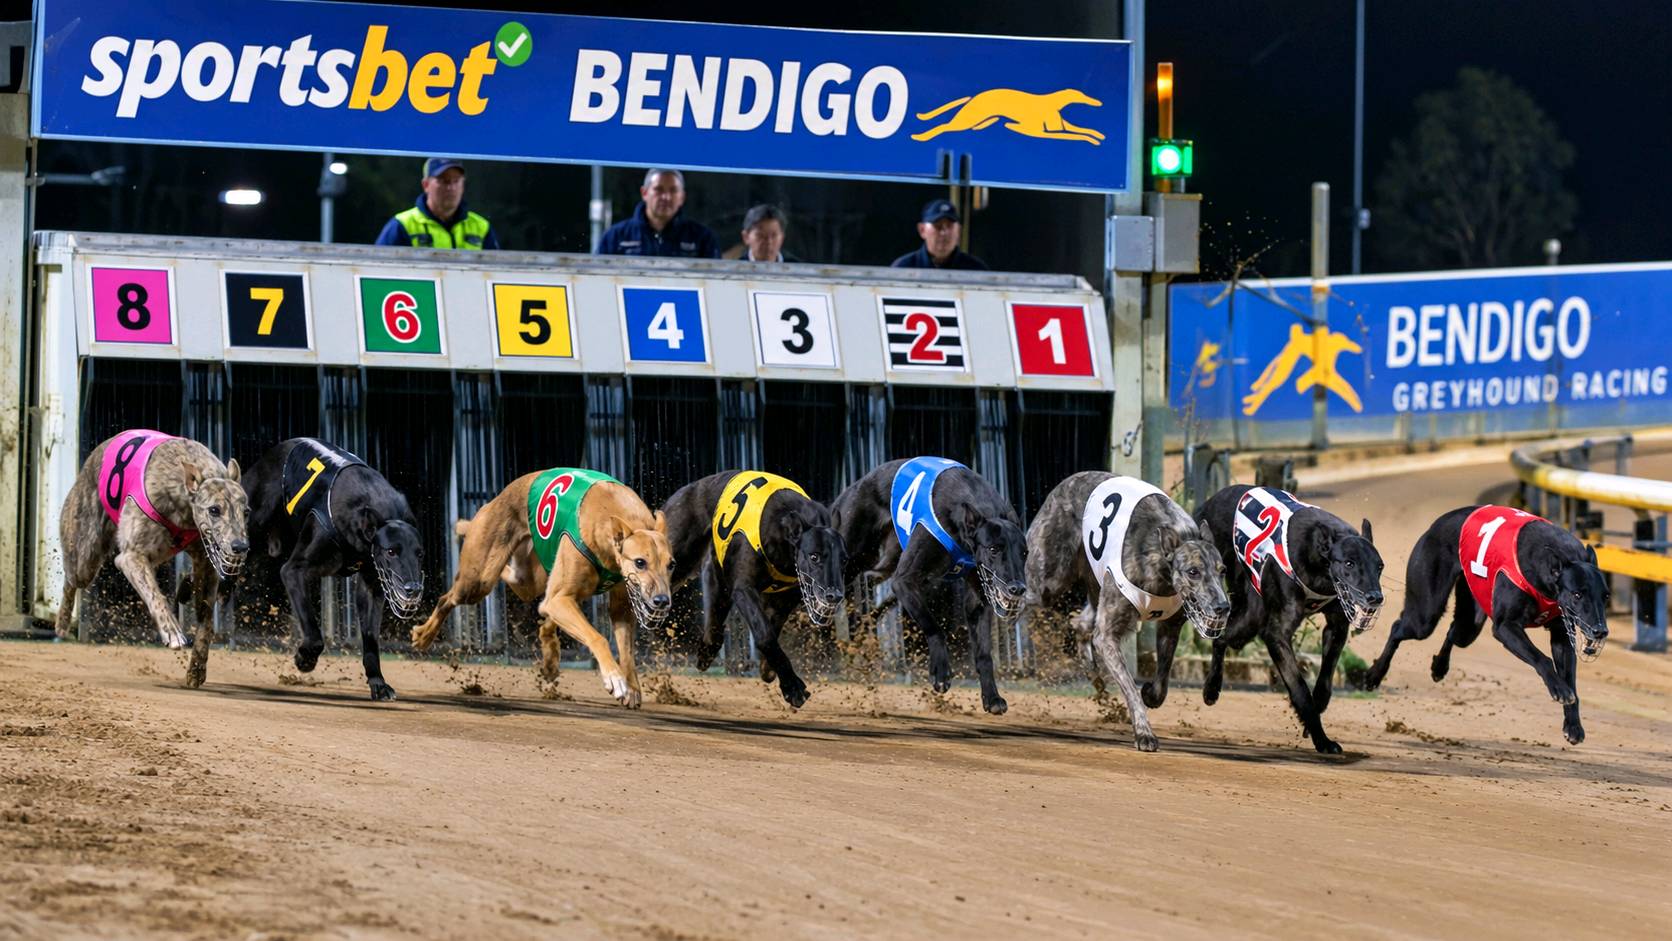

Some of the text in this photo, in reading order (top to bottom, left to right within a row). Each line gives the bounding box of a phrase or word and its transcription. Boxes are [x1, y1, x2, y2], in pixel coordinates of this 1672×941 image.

[81, 25, 909, 139] sportsbet BENDIGO
[117, 282, 151, 330] 8
[249, 287, 284, 335] 7
[381, 290, 421, 343] 6
[518, 299, 551, 345] 5
[647, 301, 684, 349] 4
[781, 307, 814, 354] 3
[1386, 296, 1591, 369] BENDIGO
[903, 312, 946, 363] 2
[1038, 318, 1067, 364] 1
[1392, 366, 1668, 412] GREYHOUND RACING
[106, 436, 146, 510] 8
[286, 457, 326, 516] 7
[536, 472, 575, 541] 6
[717, 476, 769, 541] 5
[896, 471, 927, 536] 4
[1088, 492, 1123, 562] 3
[1244, 505, 1281, 566] 2
[1470, 516, 1507, 578] 1
